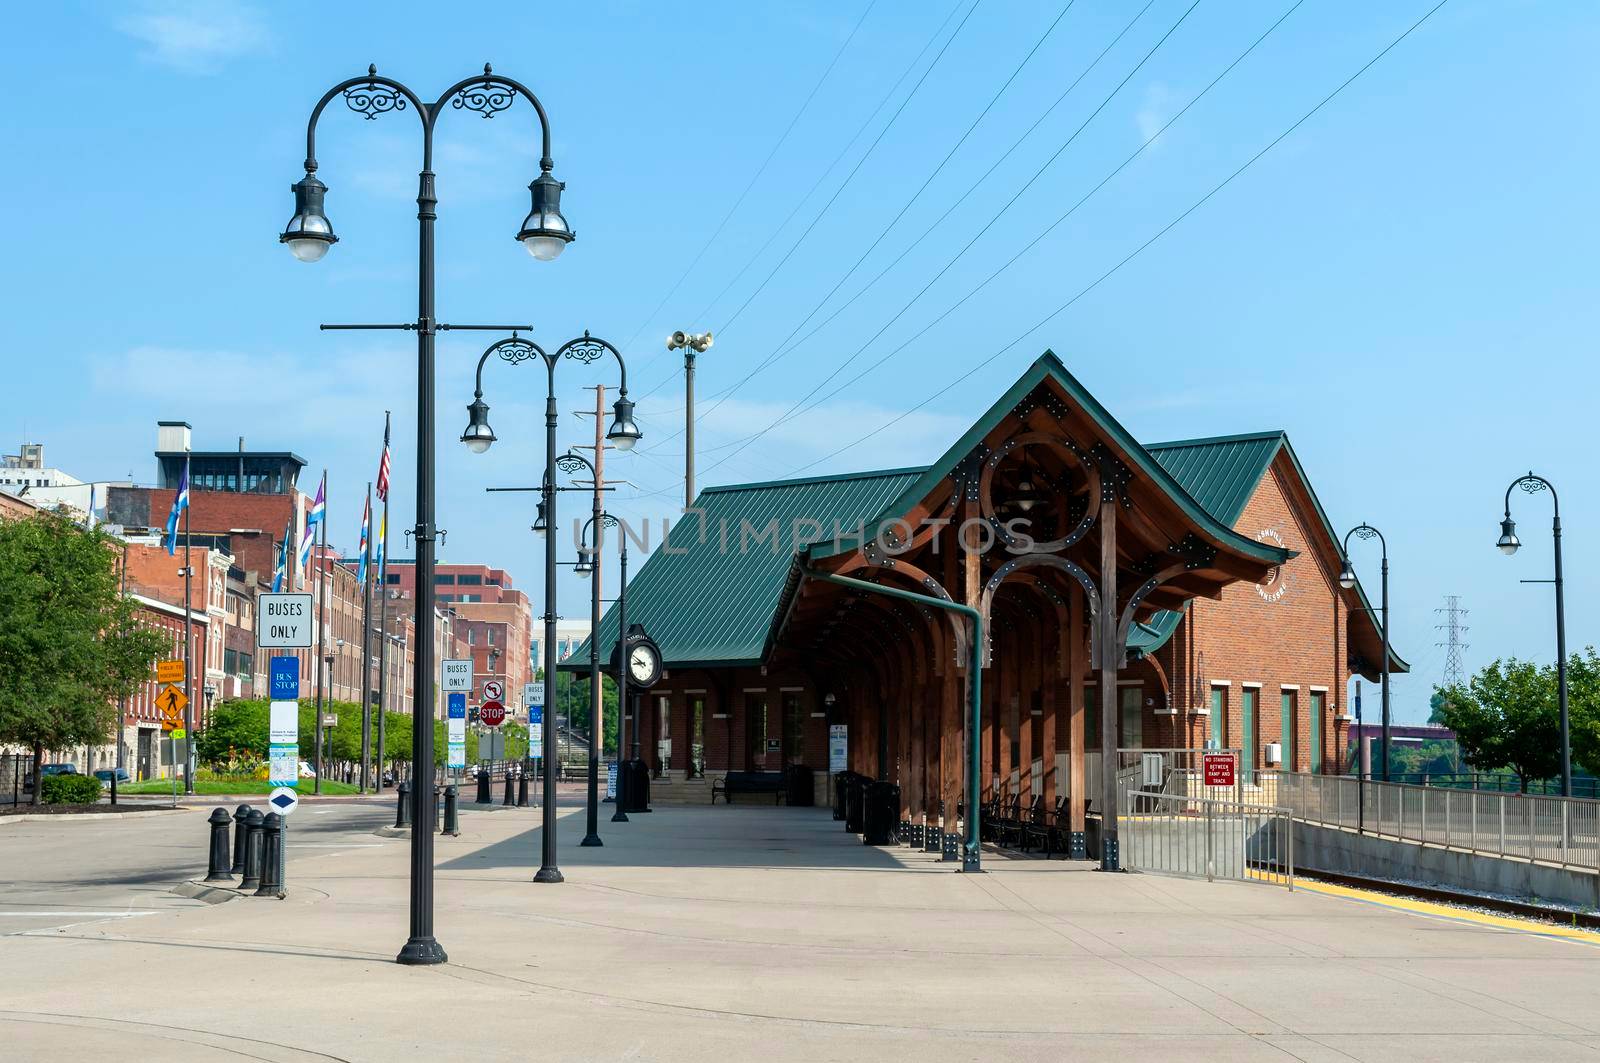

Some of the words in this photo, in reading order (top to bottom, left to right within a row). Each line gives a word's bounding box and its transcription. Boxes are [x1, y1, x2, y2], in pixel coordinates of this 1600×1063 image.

[268, 602, 303, 616] BUSES
[270, 625, 298, 639] ONLY
[447, 664, 468, 673] BUSES
[276, 672, 292, 681] BUS
[275, 681, 298, 690] STOP
[448, 678, 465, 687] ONLY
[481, 708, 504, 719] STOP
